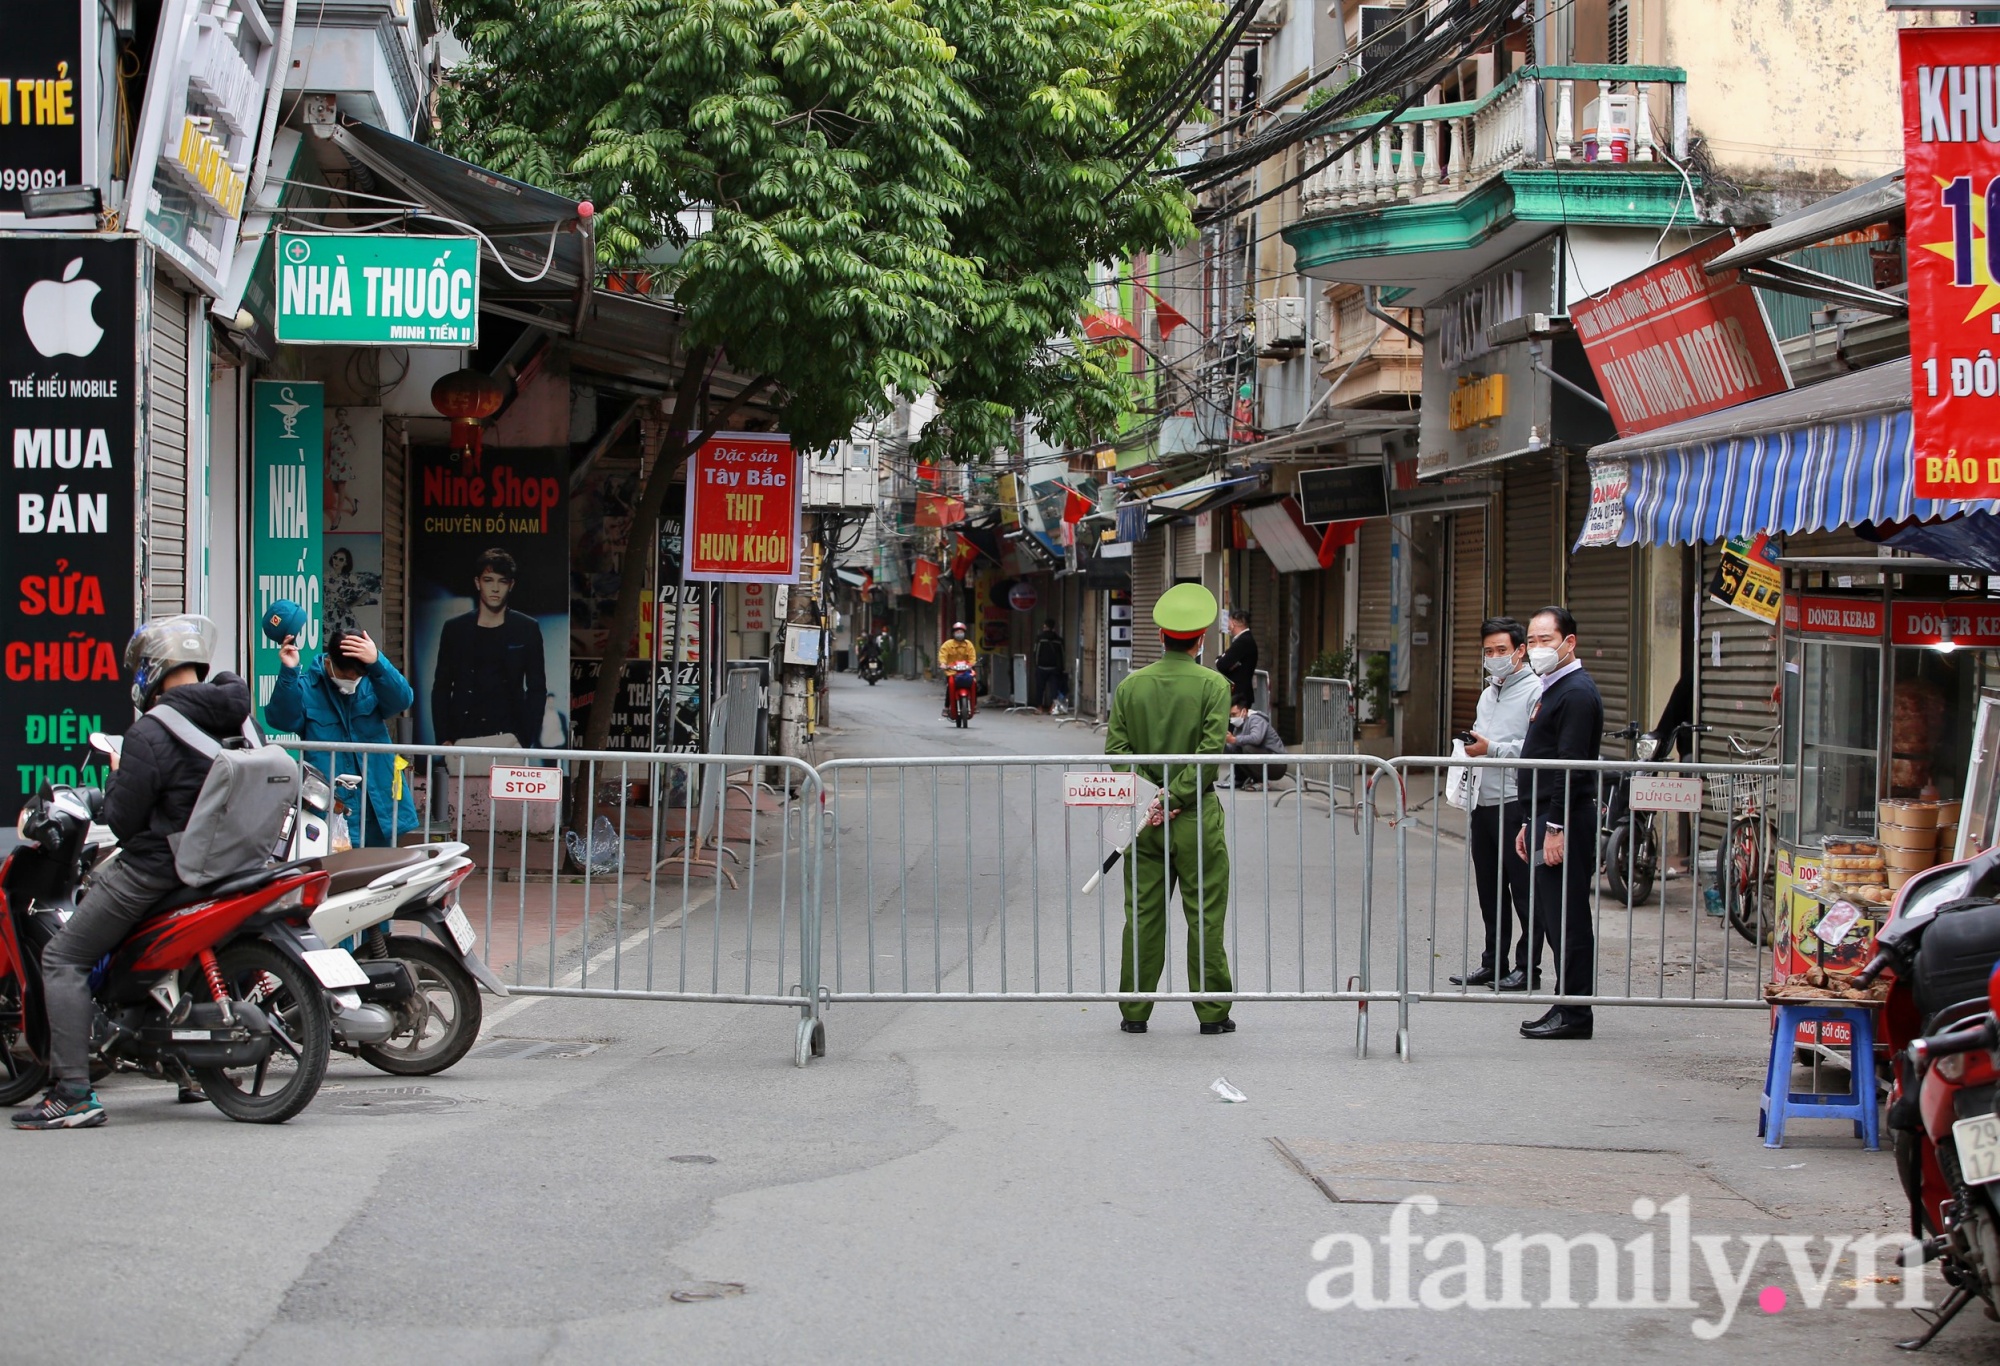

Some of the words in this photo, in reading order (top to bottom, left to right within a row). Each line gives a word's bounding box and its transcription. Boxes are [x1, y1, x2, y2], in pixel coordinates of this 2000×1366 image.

[16, 61, 74, 125] THẺ
[0, 168, 66, 191] 99091
[282, 254, 352, 317] NHÀ
[363, 250, 472, 320] THUỐC
[1642, 275, 1667, 312] SỬA
[1660, 268, 1691, 304] CHỮA
[1685, 263, 1706, 293] XE
[390, 325, 425, 340] MINH
[429, 322, 458, 341] TIẾN
[461, 327, 471, 341] II
[10, 373, 34, 398] THẾ
[38, 373, 66, 398] HIẾU
[70, 380, 118, 398] MOBILE
[1601, 346, 1648, 423] THÁI
[1627, 341, 1698, 417] HONDA
[1676, 316, 1762, 404] MOTOR
[1922, 358, 1938, 397] 1
[14, 429, 113, 469] MUA
[713, 447, 745, 464] Đặc
[749, 448, 778, 463] sản
[1926, 449, 1979, 485] BẢO
[269, 448, 309, 539] NHÀ
[705, 468, 740, 487] Tây
[747, 467, 786, 487] Bắc
[18, 485, 108, 534] BÁN
[424, 465, 486, 508] Nine
[491, 465, 560, 534] Shop
[725, 493, 764, 528] THỊT
[425, 514, 482, 533] CHUYÊN
[486, 512, 506, 533] ĐỒ
[509, 519, 539, 534] NAM
[700, 533, 738, 562] HUN
[743, 530, 786, 564] KHÓI
[19, 558, 105, 616] SỬA
[1807, 606, 1840, 627] DÖNER
[1842, 611, 1876, 630] KEBAB
[4, 631, 120, 681] CHỮA
[25, 708, 102, 751] ĐIỆN
[505, 782, 546, 793] STOP
[1108, 787, 1131, 799] LẠI
[1675, 793, 1697, 806] LẠI
